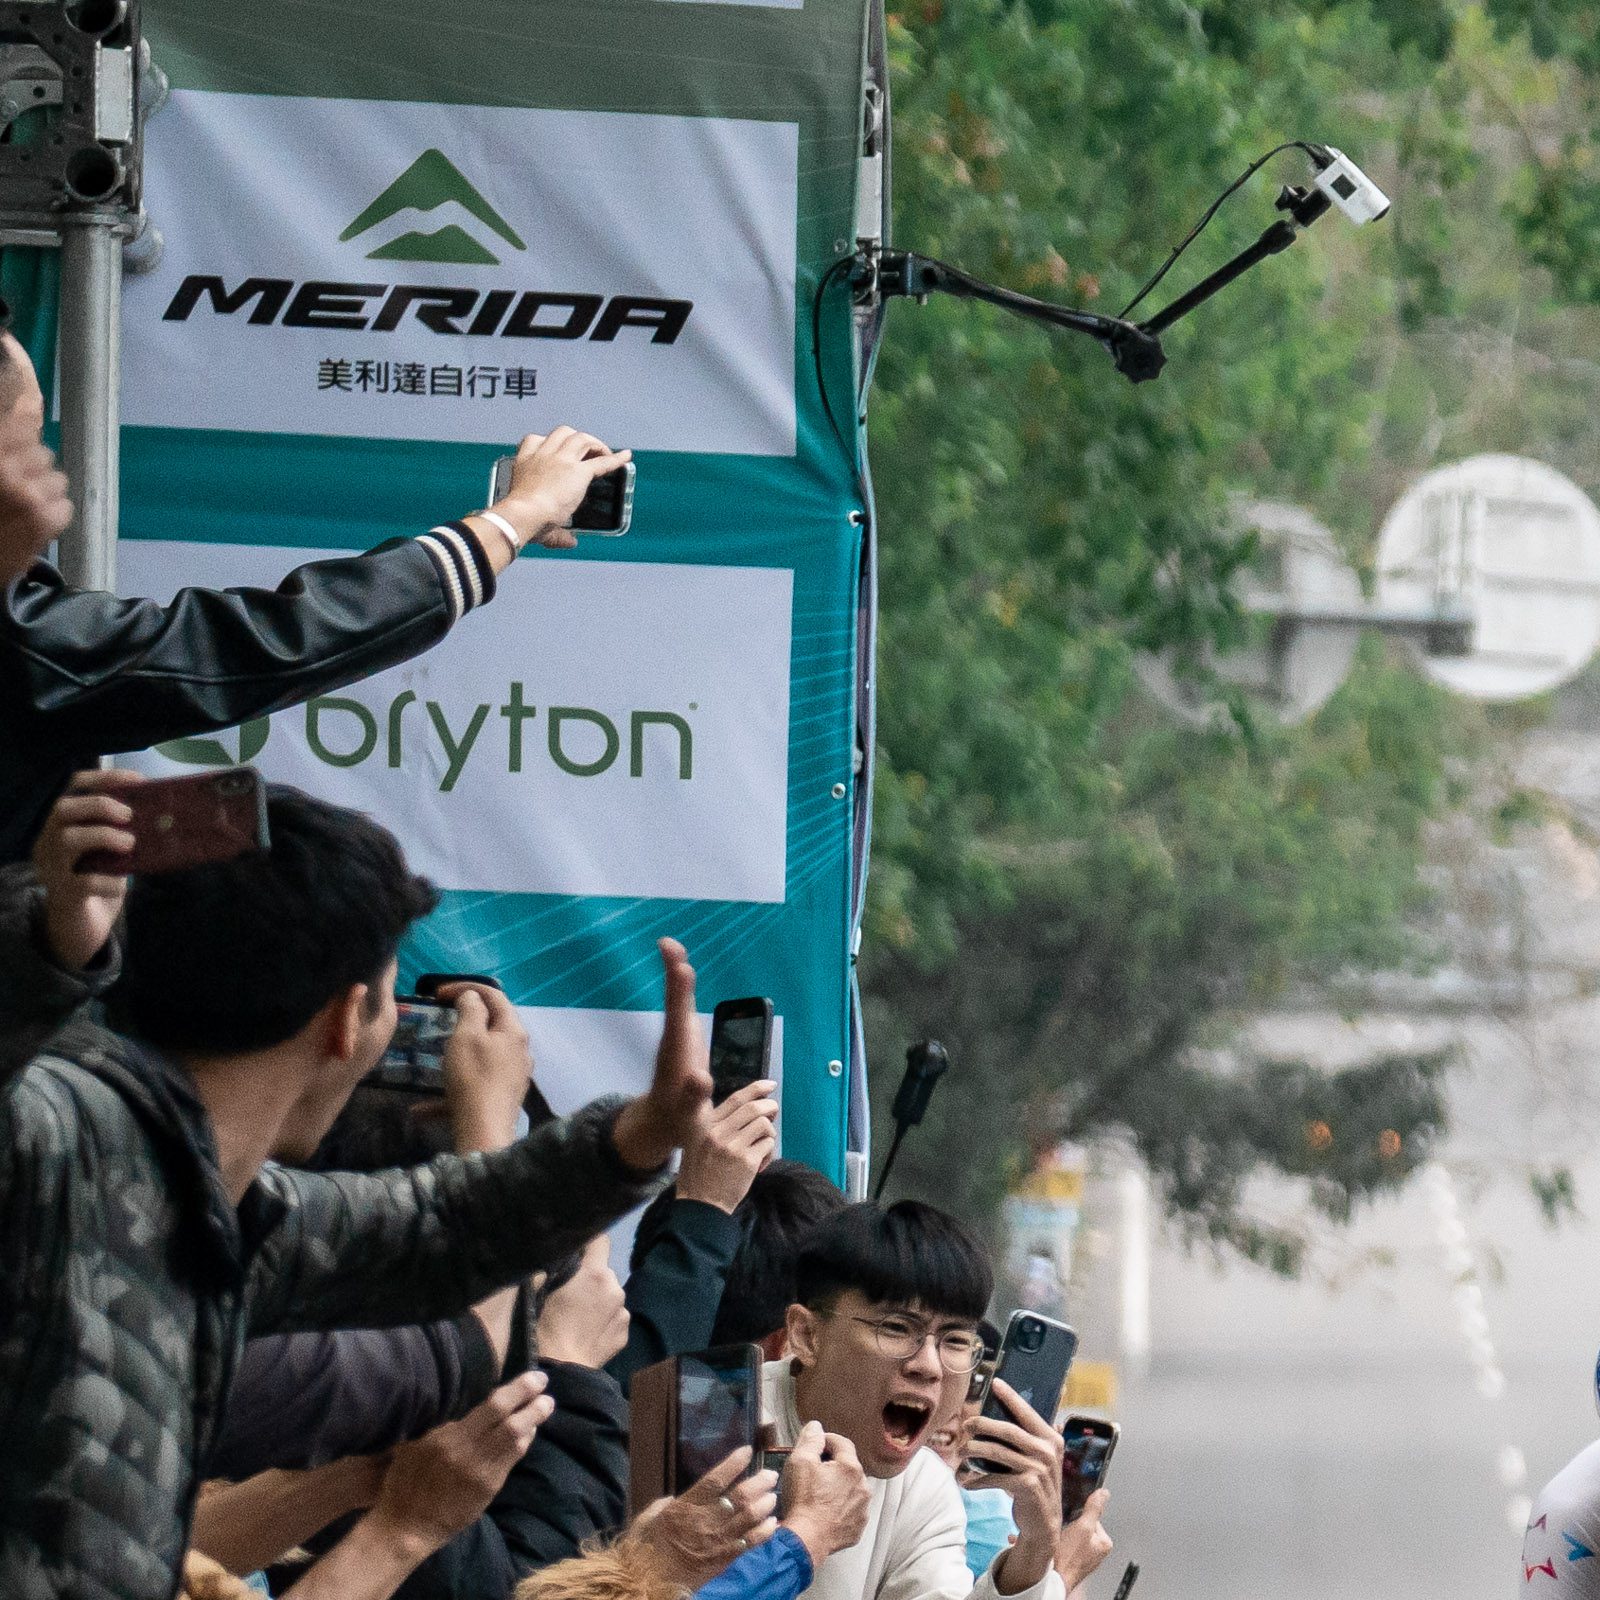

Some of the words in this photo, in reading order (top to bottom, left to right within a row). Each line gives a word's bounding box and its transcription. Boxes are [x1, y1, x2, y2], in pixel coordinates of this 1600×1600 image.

[162, 274, 694, 344] MERIDA
[317, 358, 538, 400] 美利達自行車
[305, 681, 693, 792] bryton
